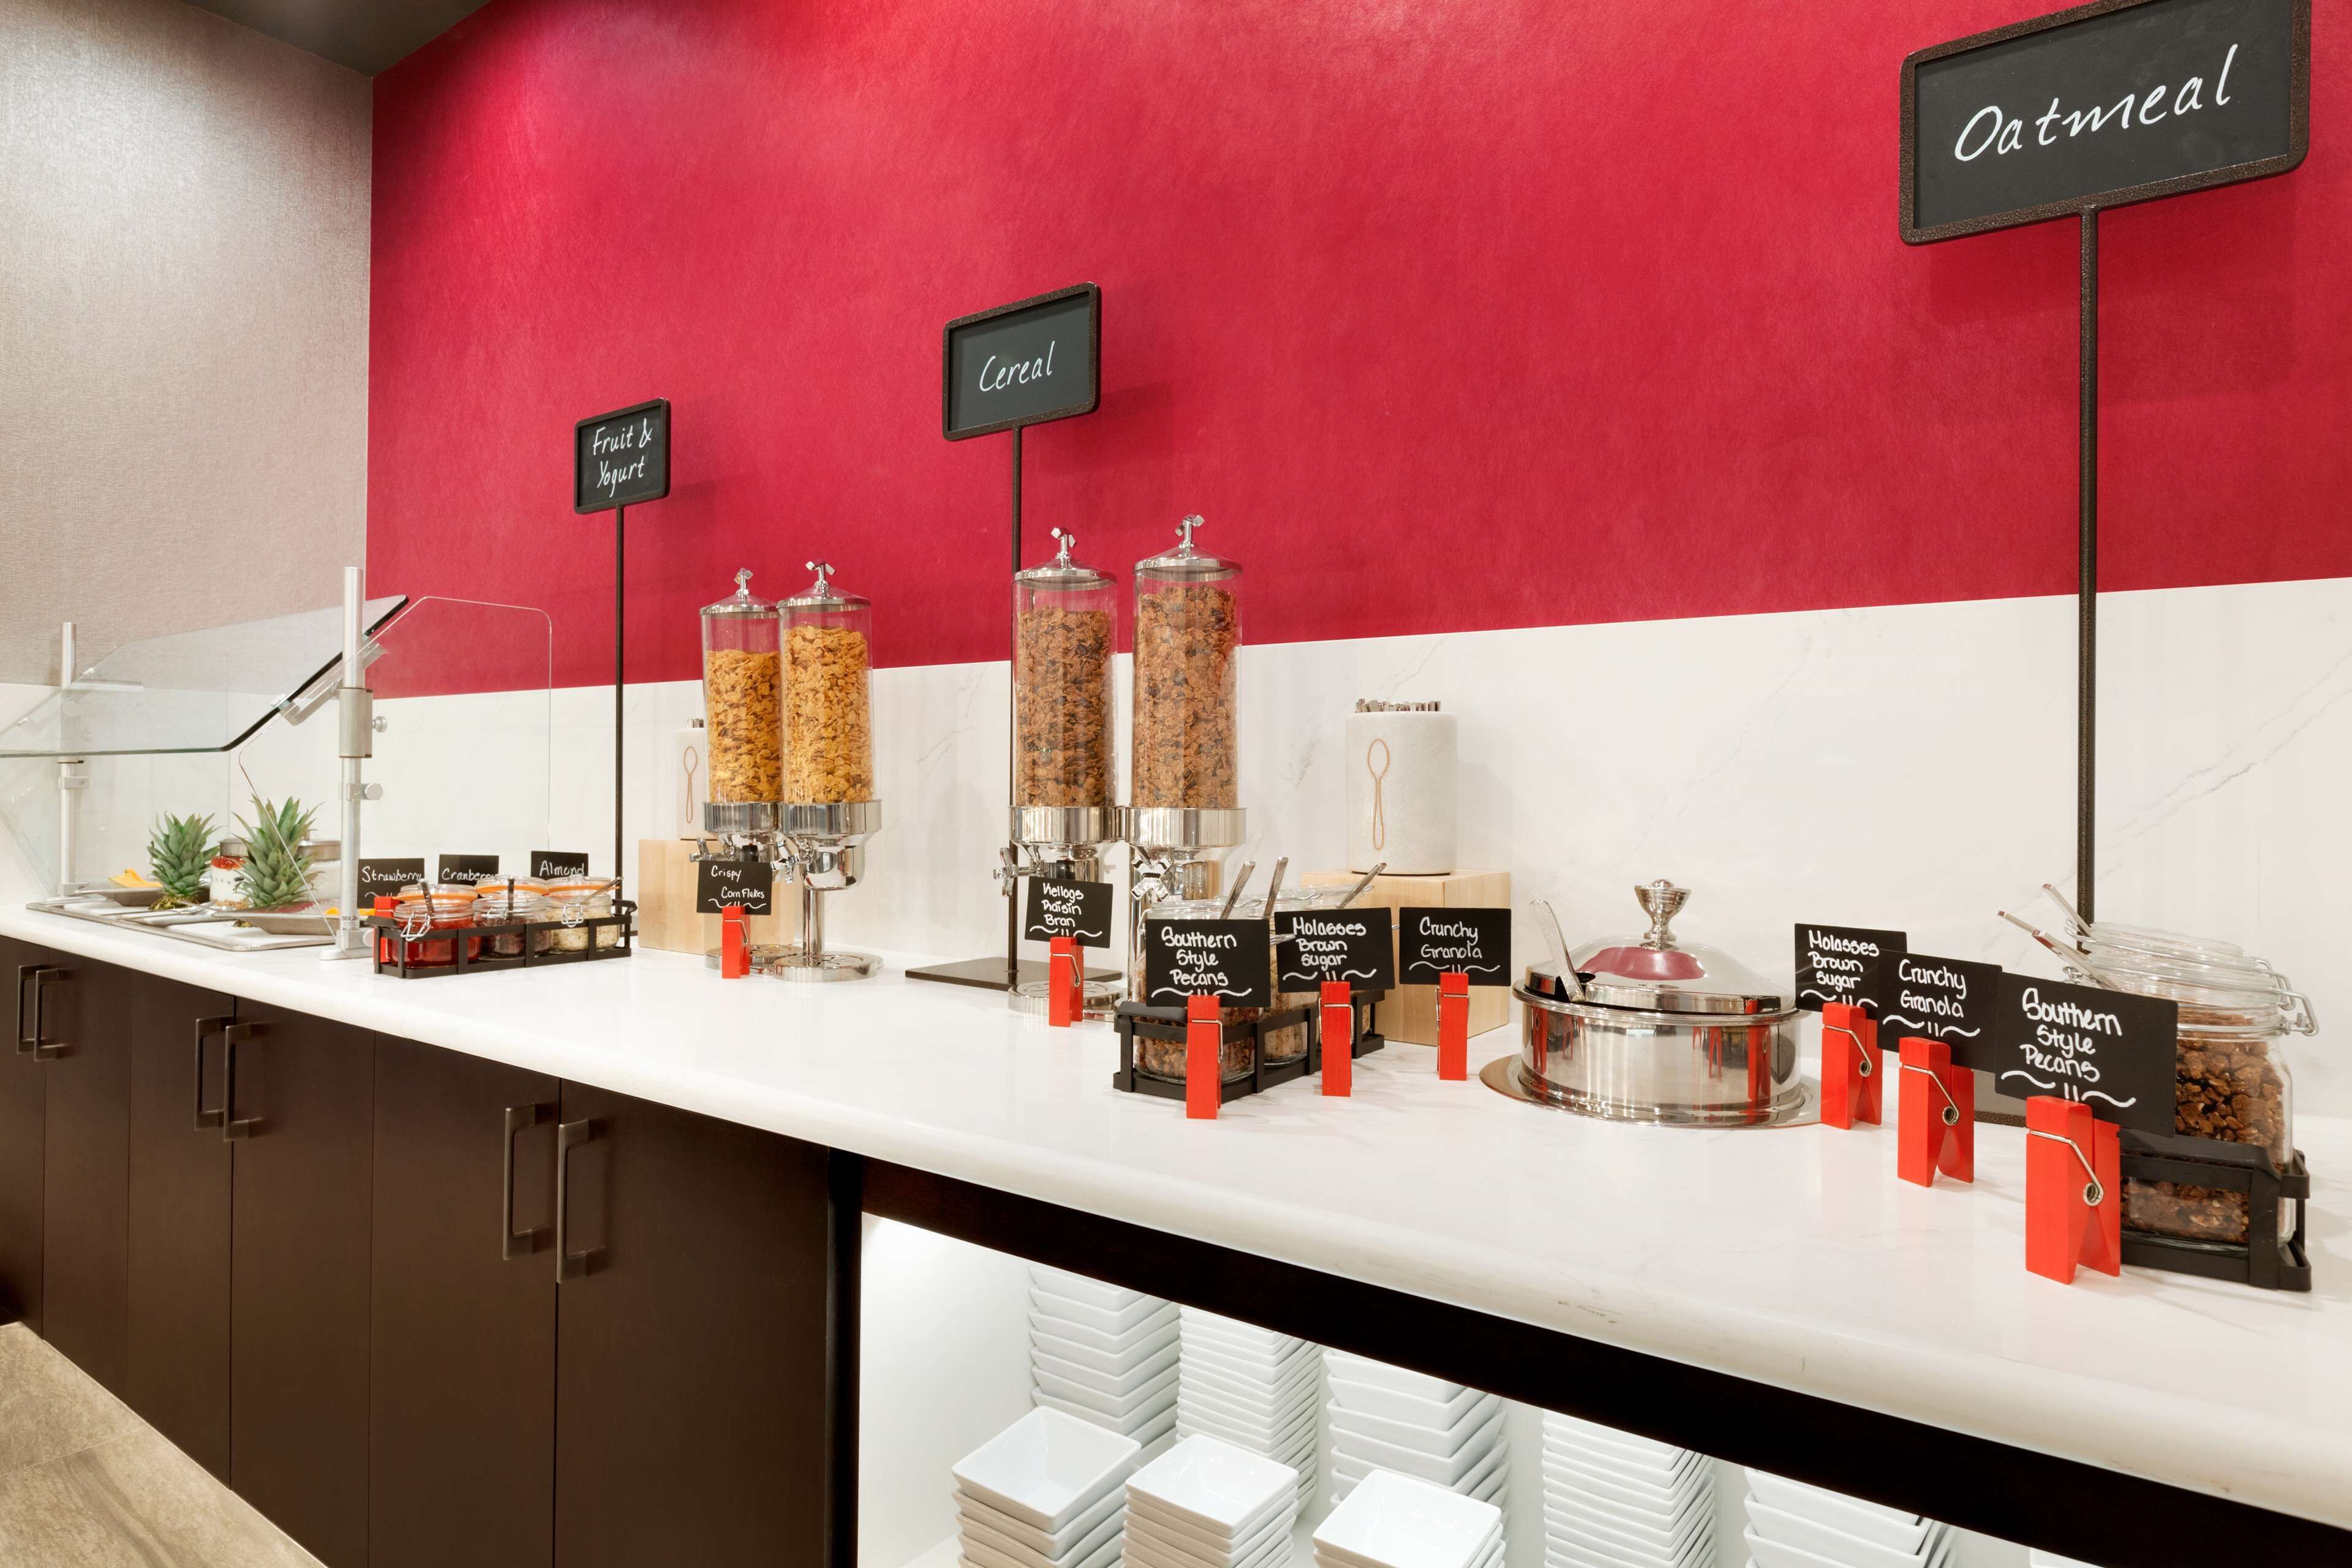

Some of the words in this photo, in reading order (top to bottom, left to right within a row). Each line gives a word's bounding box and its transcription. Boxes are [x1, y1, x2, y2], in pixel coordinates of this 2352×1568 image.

[1954, 43, 2239, 162] Oatmeal
[979, 340, 1055, 392] Cereal
[592, 424, 634, 456] Fruit
[638, 417, 653, 448] &
[597, 455, 645, 498] Yogurt
[362, 865, 422, 883] Strawberry
[539, 859, 584, 876] Almond
[711, 865, 741, 883] Crispy
[1041, 899, 1082, 915] Raisin
[1043, 913, 1076, 927] Bran
[1292, 916, 1366, 937] Molasses
[1419, 916, 1479, 946] Crunchy
[1161, 925, 1237, 949] Southern
[1295, 938, 1348, 952] Brown
[1808, 930, 1880, 957] Molasses
[1176, 949, 1219, 973] Style
[1420, 941, 1483, 959] Granola
[1807, 951, 1864, 973] Brown
[1169, 968, 1229, 986] Pecans
[1898, 959, 1967, 1000] Crunchy
[1900, 989, 1964, 1018] Granola
[2022, 987, 2123, 1036] Southern
[2036, 1023, 2097, 1058] Style
[2019, 1043, 2101, 1083] Pecans
